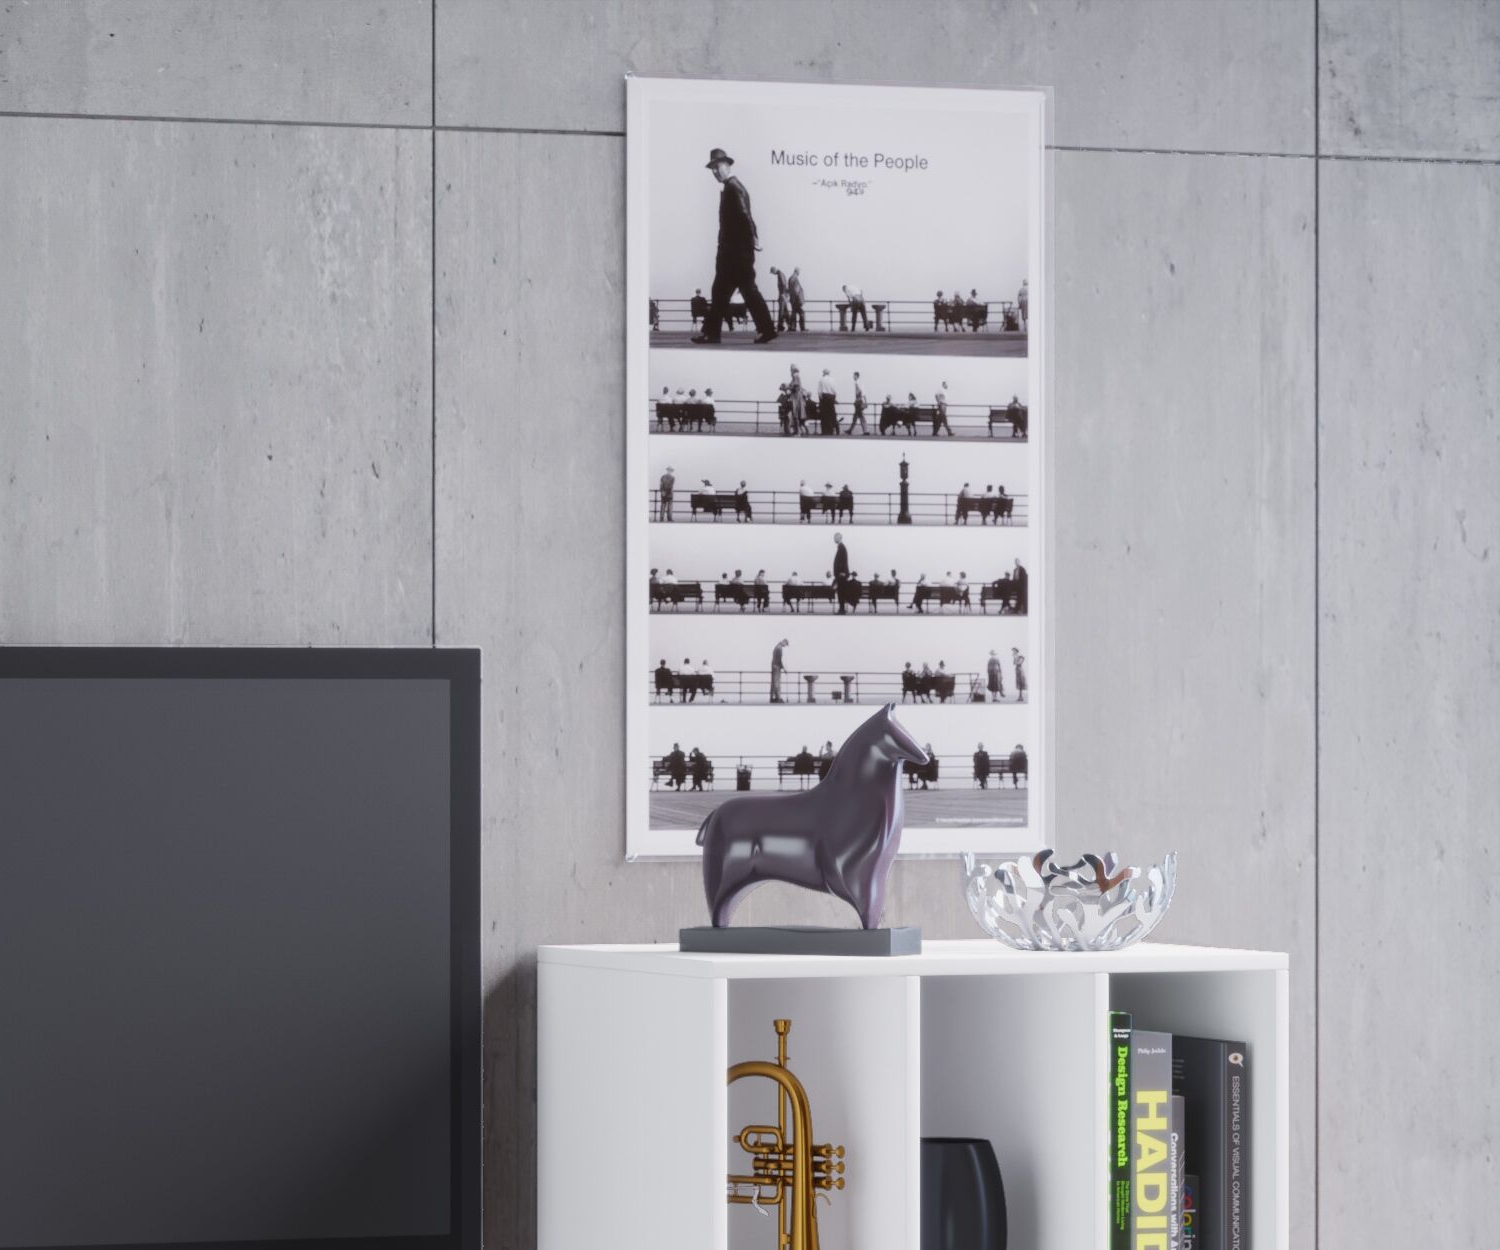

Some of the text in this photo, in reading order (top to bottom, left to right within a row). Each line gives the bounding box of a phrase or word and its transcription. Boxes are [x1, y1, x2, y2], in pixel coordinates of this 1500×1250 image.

[771, 150, 928, 172] Music of the People
[1115, 1046, 1128, 1167] Design Research
[1232, 1076, 1240, 1129] ESSENTIALS
[1232, 1131, 1240, 1145] OF
[1232, 1148, 1240, 1179] VISUAL
